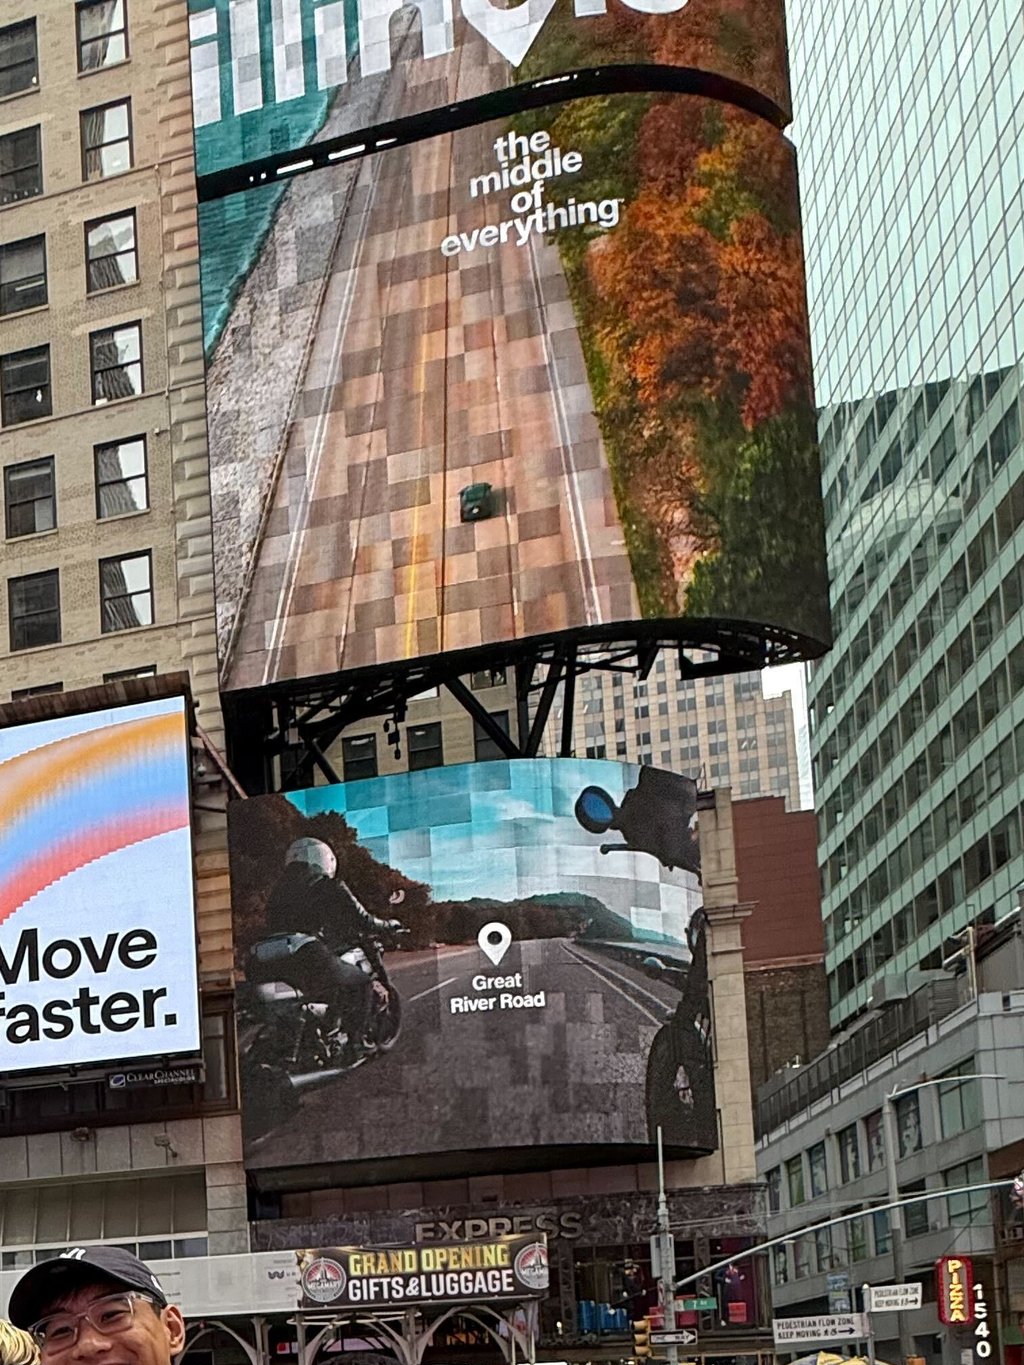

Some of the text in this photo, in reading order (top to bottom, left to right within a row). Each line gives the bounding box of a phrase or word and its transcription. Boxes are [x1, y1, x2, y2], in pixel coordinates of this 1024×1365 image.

[493, 130, 551, 163] the
[470, 148, 583, 198] middle
[511, 180, 545, 213] of
[471, 972, 523, 991] Great
[450, 991, 546, 1014] River Road
[348, 1243, 512, 1277] GRAND OPENING
[947, 1259, 966, 1322] PIZZA
[777, 1316, 855, 1330] PEDESTRIAN FLOW ZONE
[777, 1328, 822, 1340] KEEP MOVING
[972, 1283, 992, 1358] 1540
